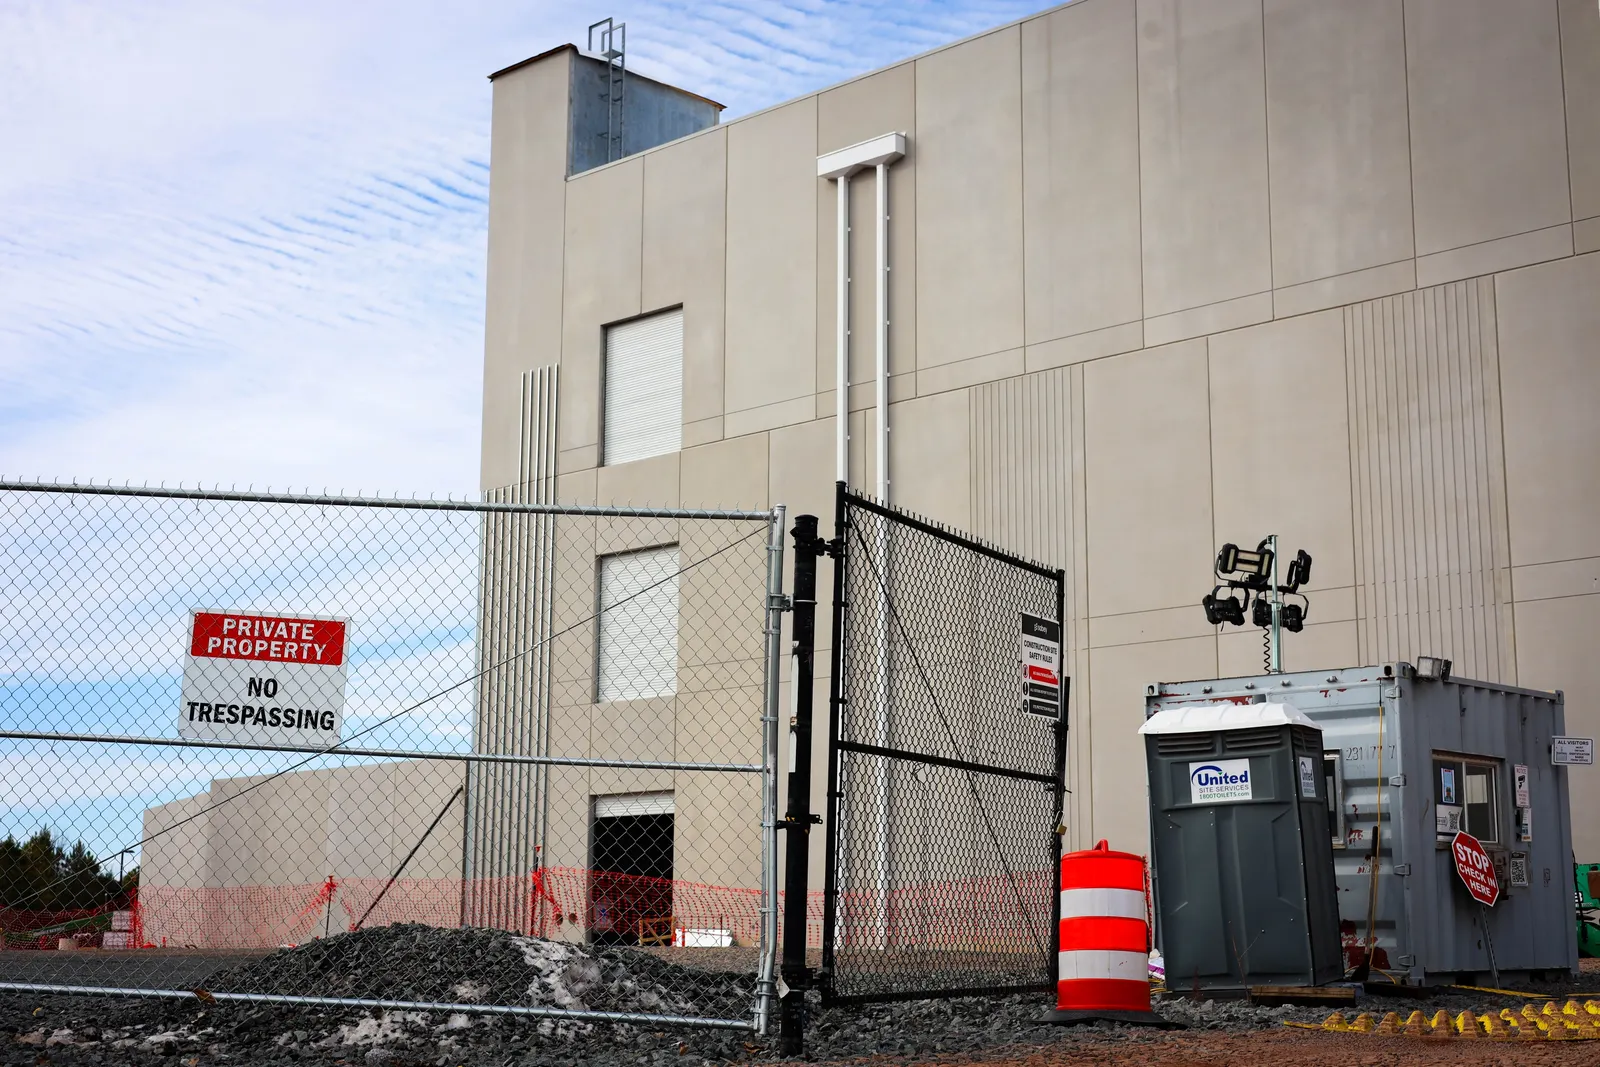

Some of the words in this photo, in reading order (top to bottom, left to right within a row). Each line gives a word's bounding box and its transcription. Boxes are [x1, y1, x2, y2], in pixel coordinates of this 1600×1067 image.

[223, 618, 315, 641] PRIVATE
[207, 637, 327, 661] PROPERTY
[1024, 639, 1050, 653] CONSTRUCTION
[1050, 647, 1058, 655] SITE
[1029, 651, 1042, 661] SAFETY
[1042, 654, 1053, 664] RULES
[248, 677, 278, 699] NO
[187, 701, 335, 731] TRESPASSING
[1197, 770, 1249, 786] United
[1199, 786, 1214, 794] SITE
[1215, 784, 1249, 793] SERVICES
[1199, 791, 1250, 800] 1800TOILETS.com
[1455, 842, 1490, 873] STOP
[1458, 863, 1486, 883] CHECK
[1487, 876, 1496, 889] IN
[1470, 880, 1492, 898] HERE
